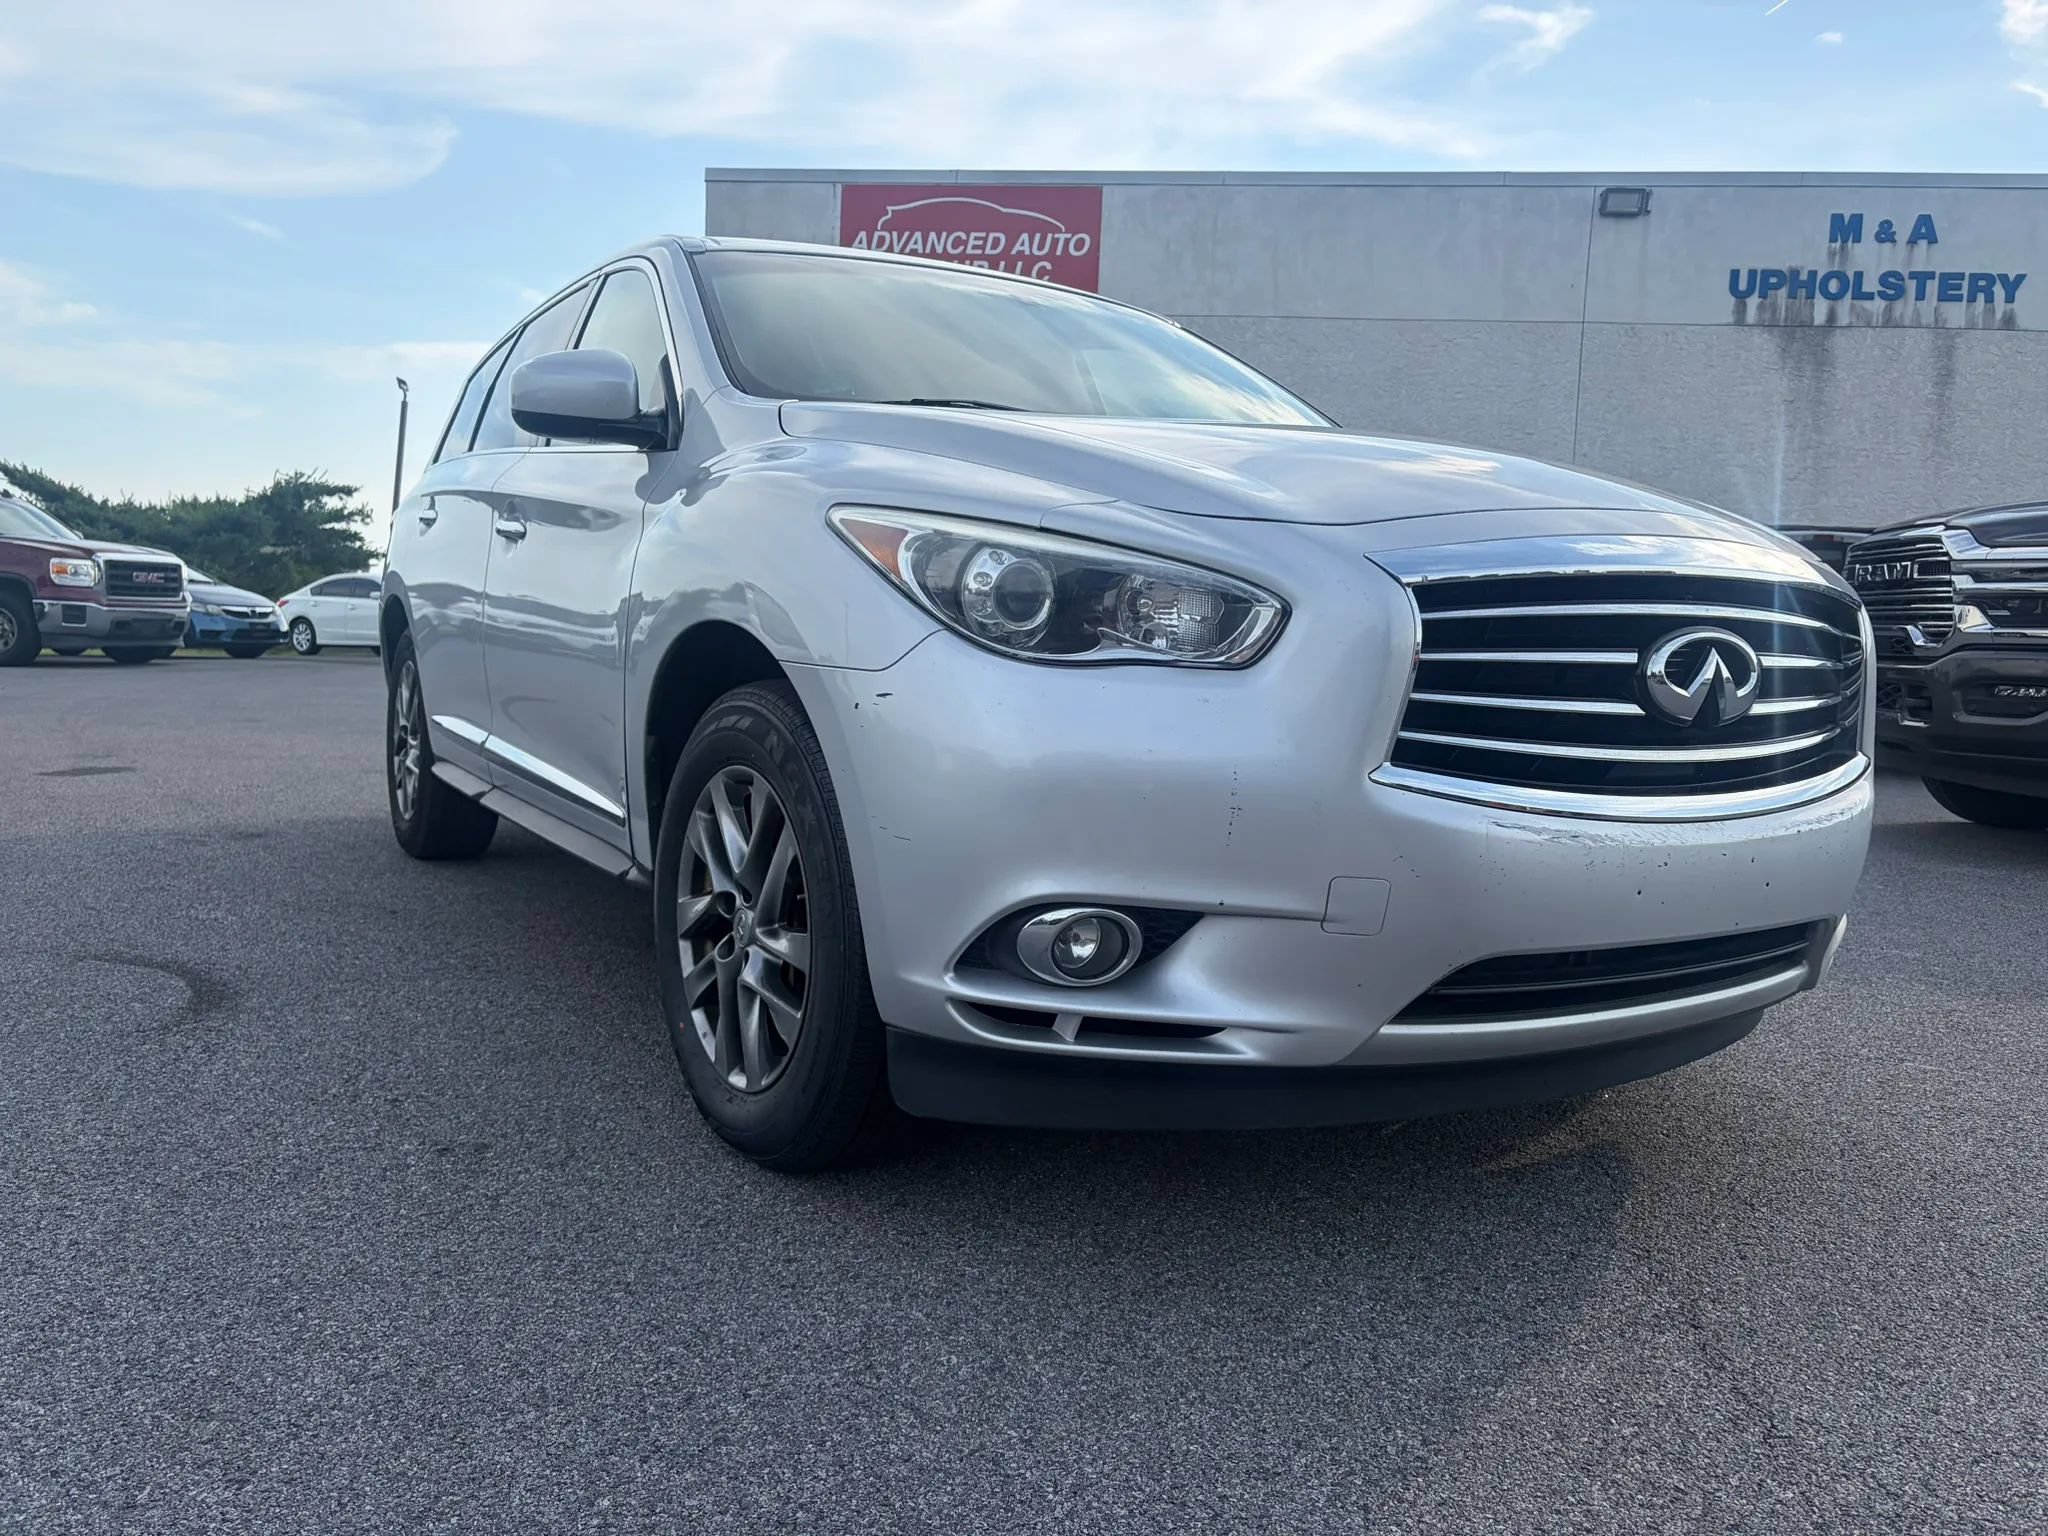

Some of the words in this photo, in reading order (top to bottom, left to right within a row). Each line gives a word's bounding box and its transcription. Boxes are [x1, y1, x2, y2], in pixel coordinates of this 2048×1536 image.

[1828, 213, 1864, 243] M
[1874, 219, 1897, 243] &
[1906, 214, 1938, 244] A
[851, 230, 1006, 255] ADVANCED
[1011, 232, 1091, 256] AUTO
[1728, 269, 2027, 304] UPHOLSTERY
[1855, 561, 1912, 584] RAM
